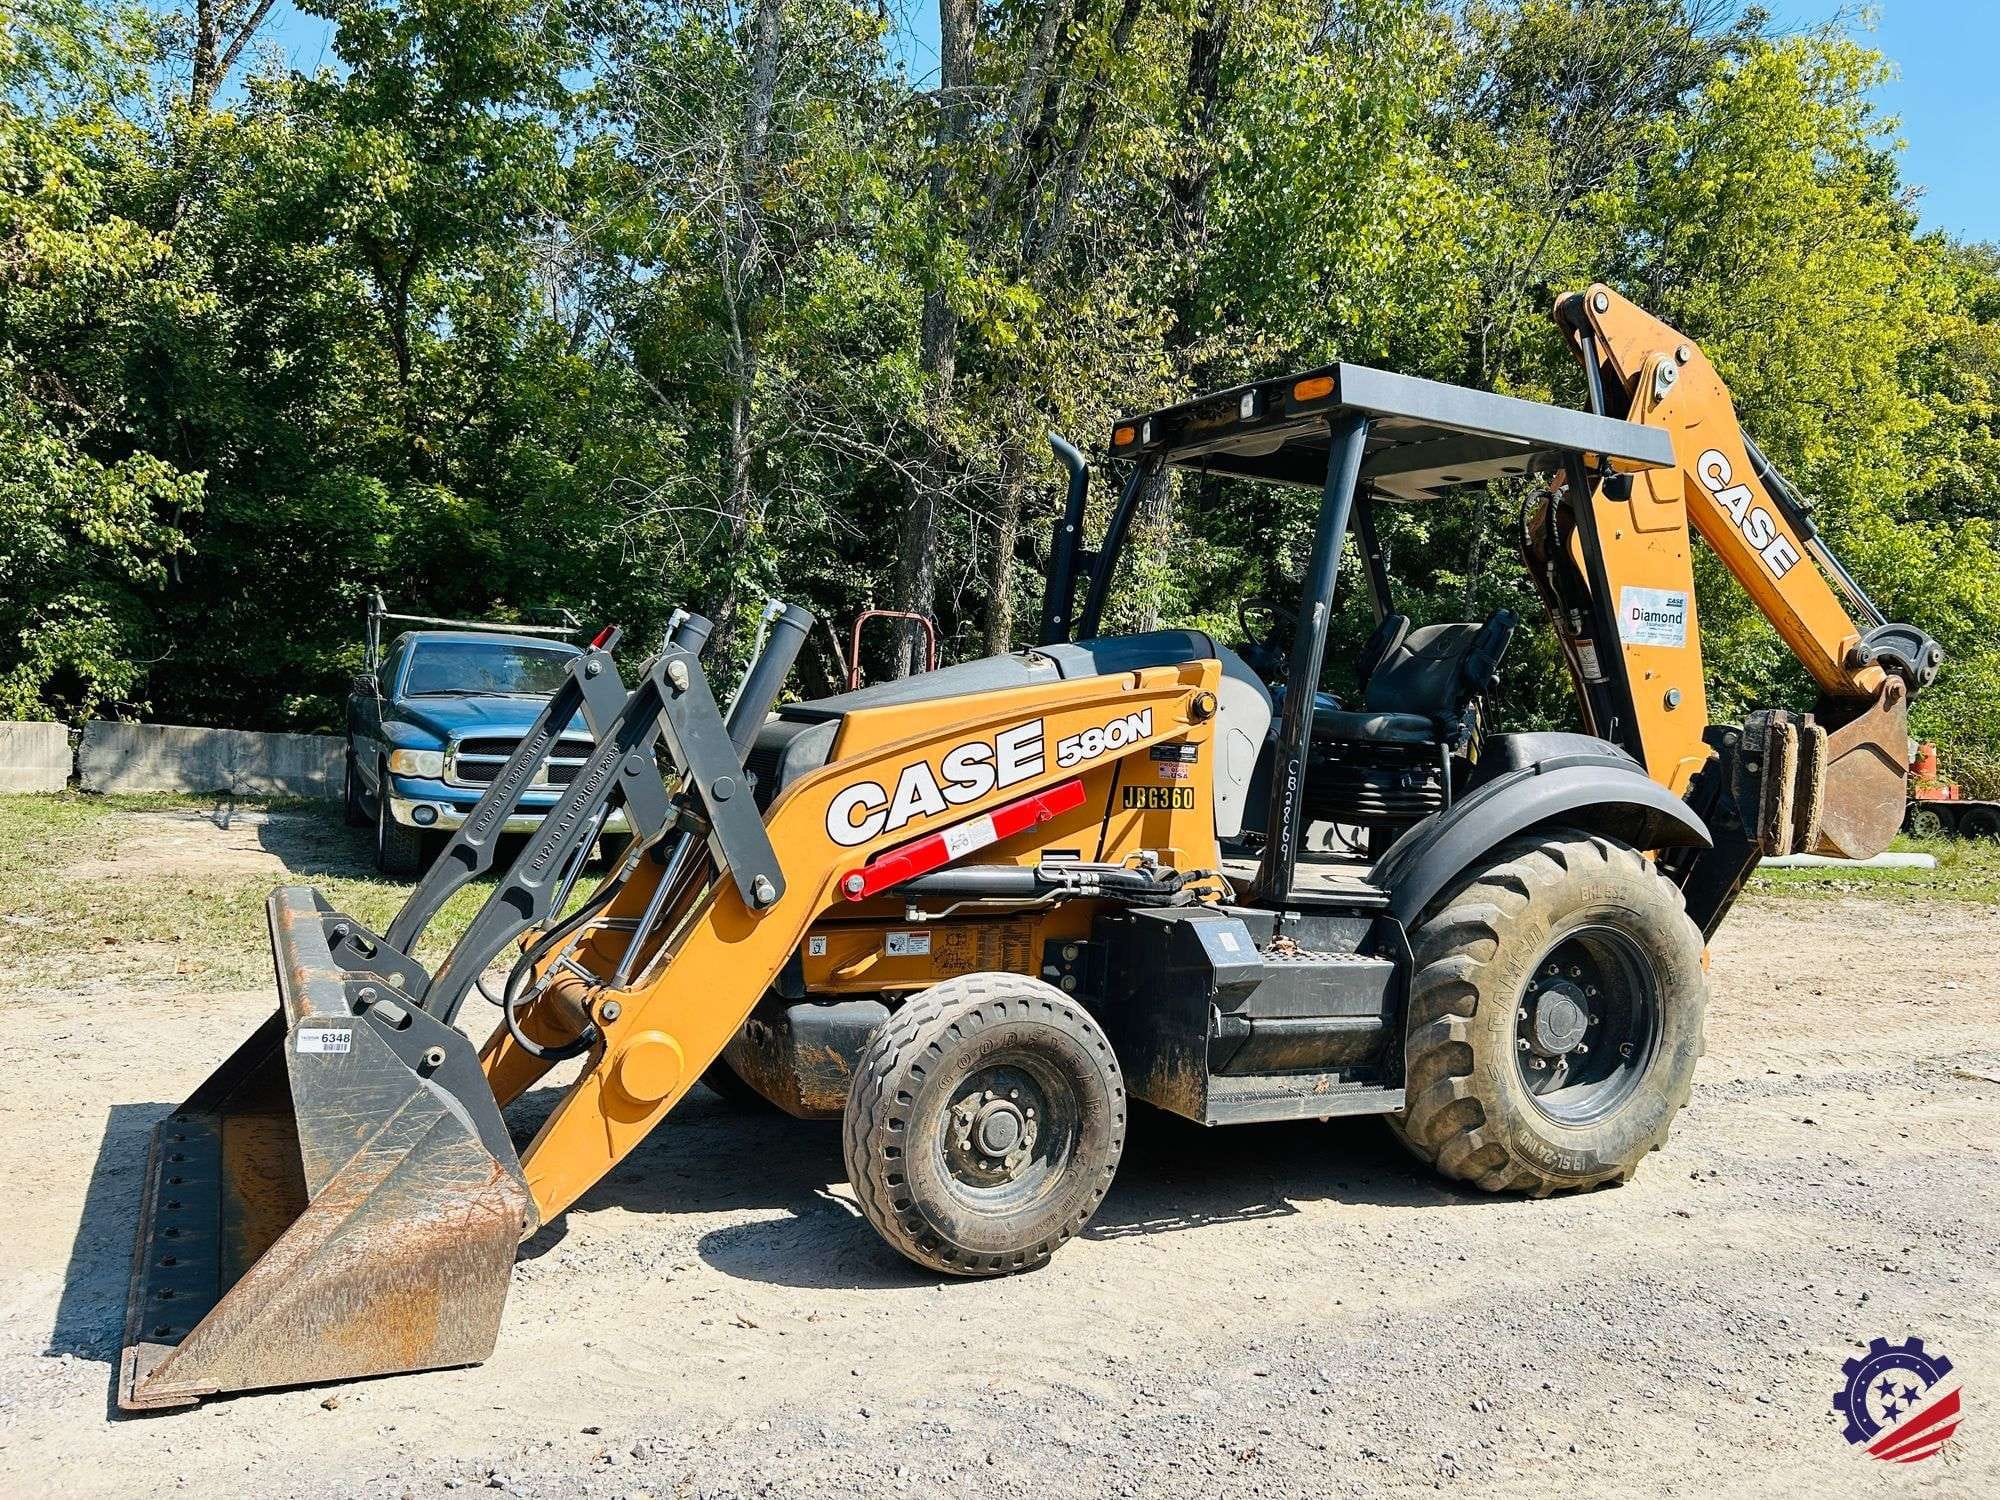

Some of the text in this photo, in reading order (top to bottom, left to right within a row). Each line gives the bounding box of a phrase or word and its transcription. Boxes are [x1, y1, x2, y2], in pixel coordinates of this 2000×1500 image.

[1697, 449, 1801, 580] CASE
[1632, 608, 1683, 625] Diamond
[826, 707, 1153, 847] CASE 580N
[1125, 787, 1193, 809] JBG360
[322, 1034, 350, 1043] 6348
